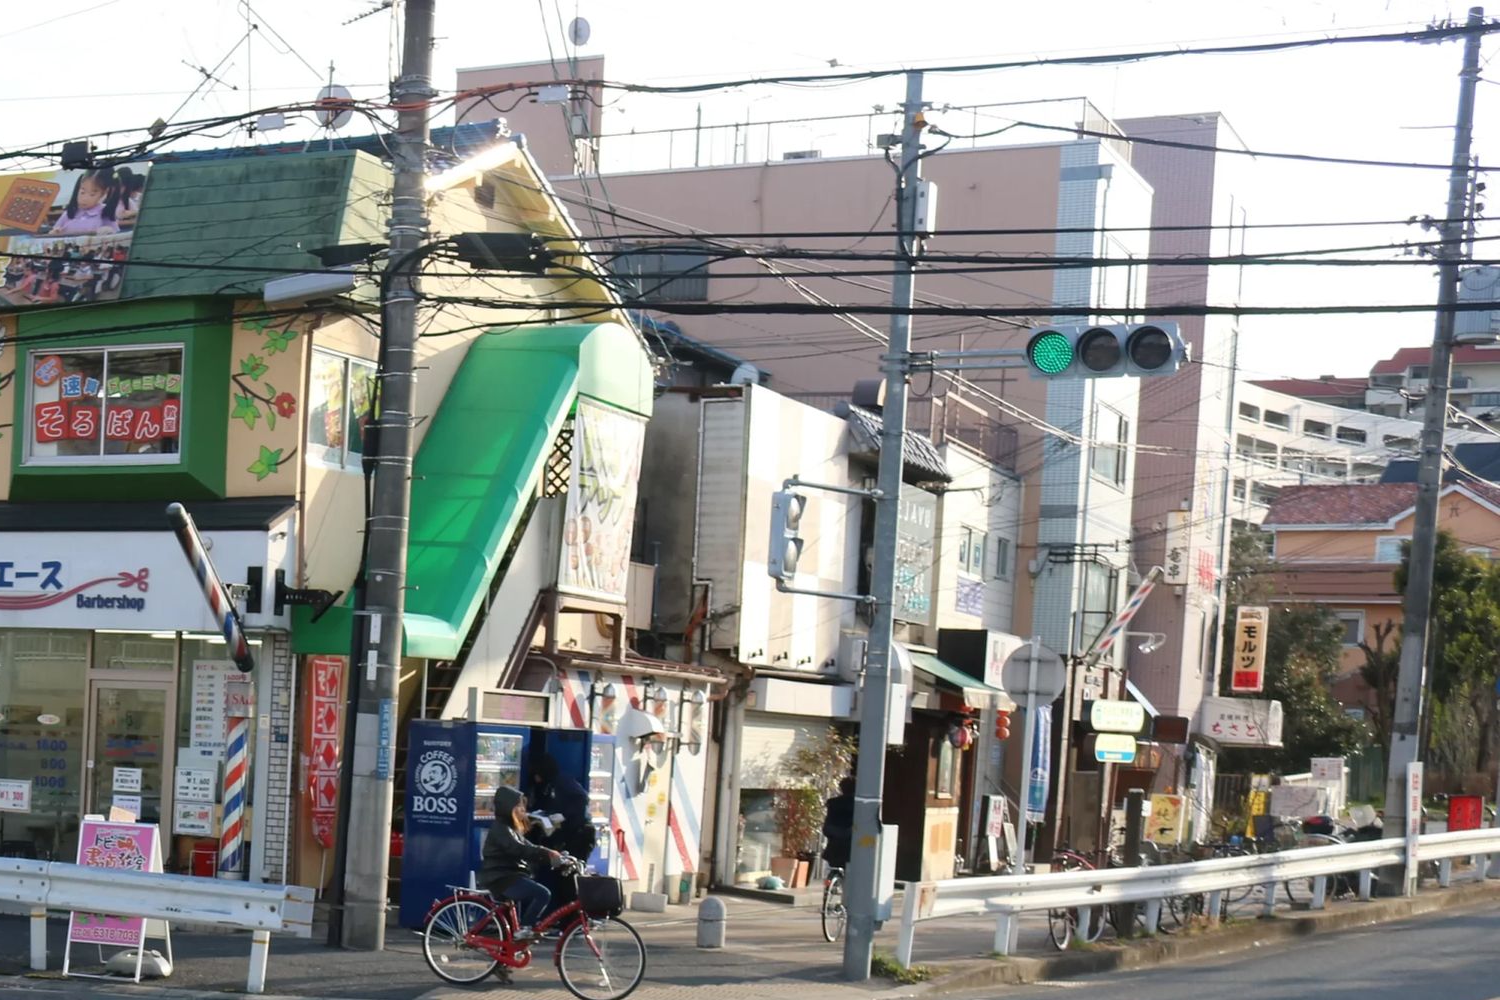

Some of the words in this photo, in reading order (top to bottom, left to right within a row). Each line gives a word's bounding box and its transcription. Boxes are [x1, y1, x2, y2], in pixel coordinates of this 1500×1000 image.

[37, 406, 160, 440] そろばん
[77, 594, 145, 612] Barbershop
[1241, 625, 1258, 669] モルツ
[1211, 721, 1256, 738] ちさと
[420, 751, 455, 765] COFFEE
[412, 796, 458, 814] BOSS
